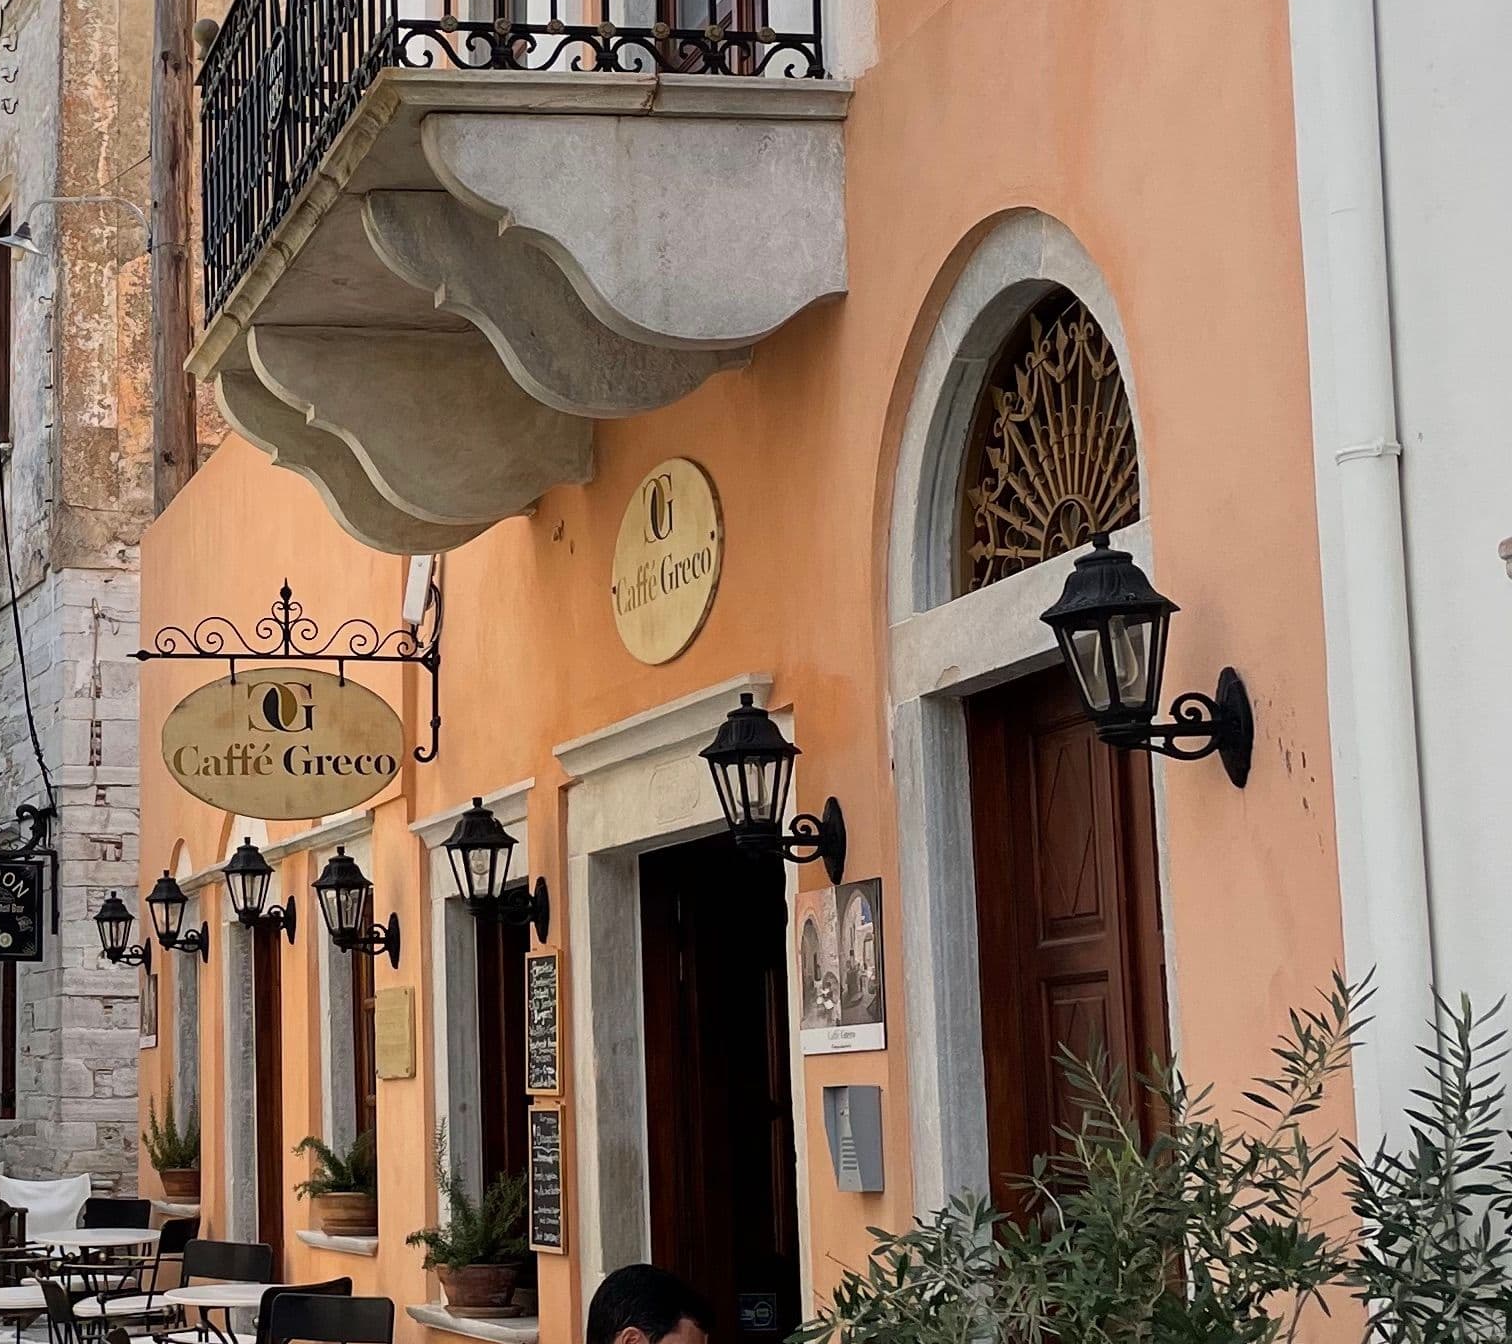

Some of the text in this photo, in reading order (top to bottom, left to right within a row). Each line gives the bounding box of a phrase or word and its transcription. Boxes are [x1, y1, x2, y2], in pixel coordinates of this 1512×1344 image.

[615, 546, 712, 617] Caffé Greco
[172, 742, 397, 778] Caffé Greco
